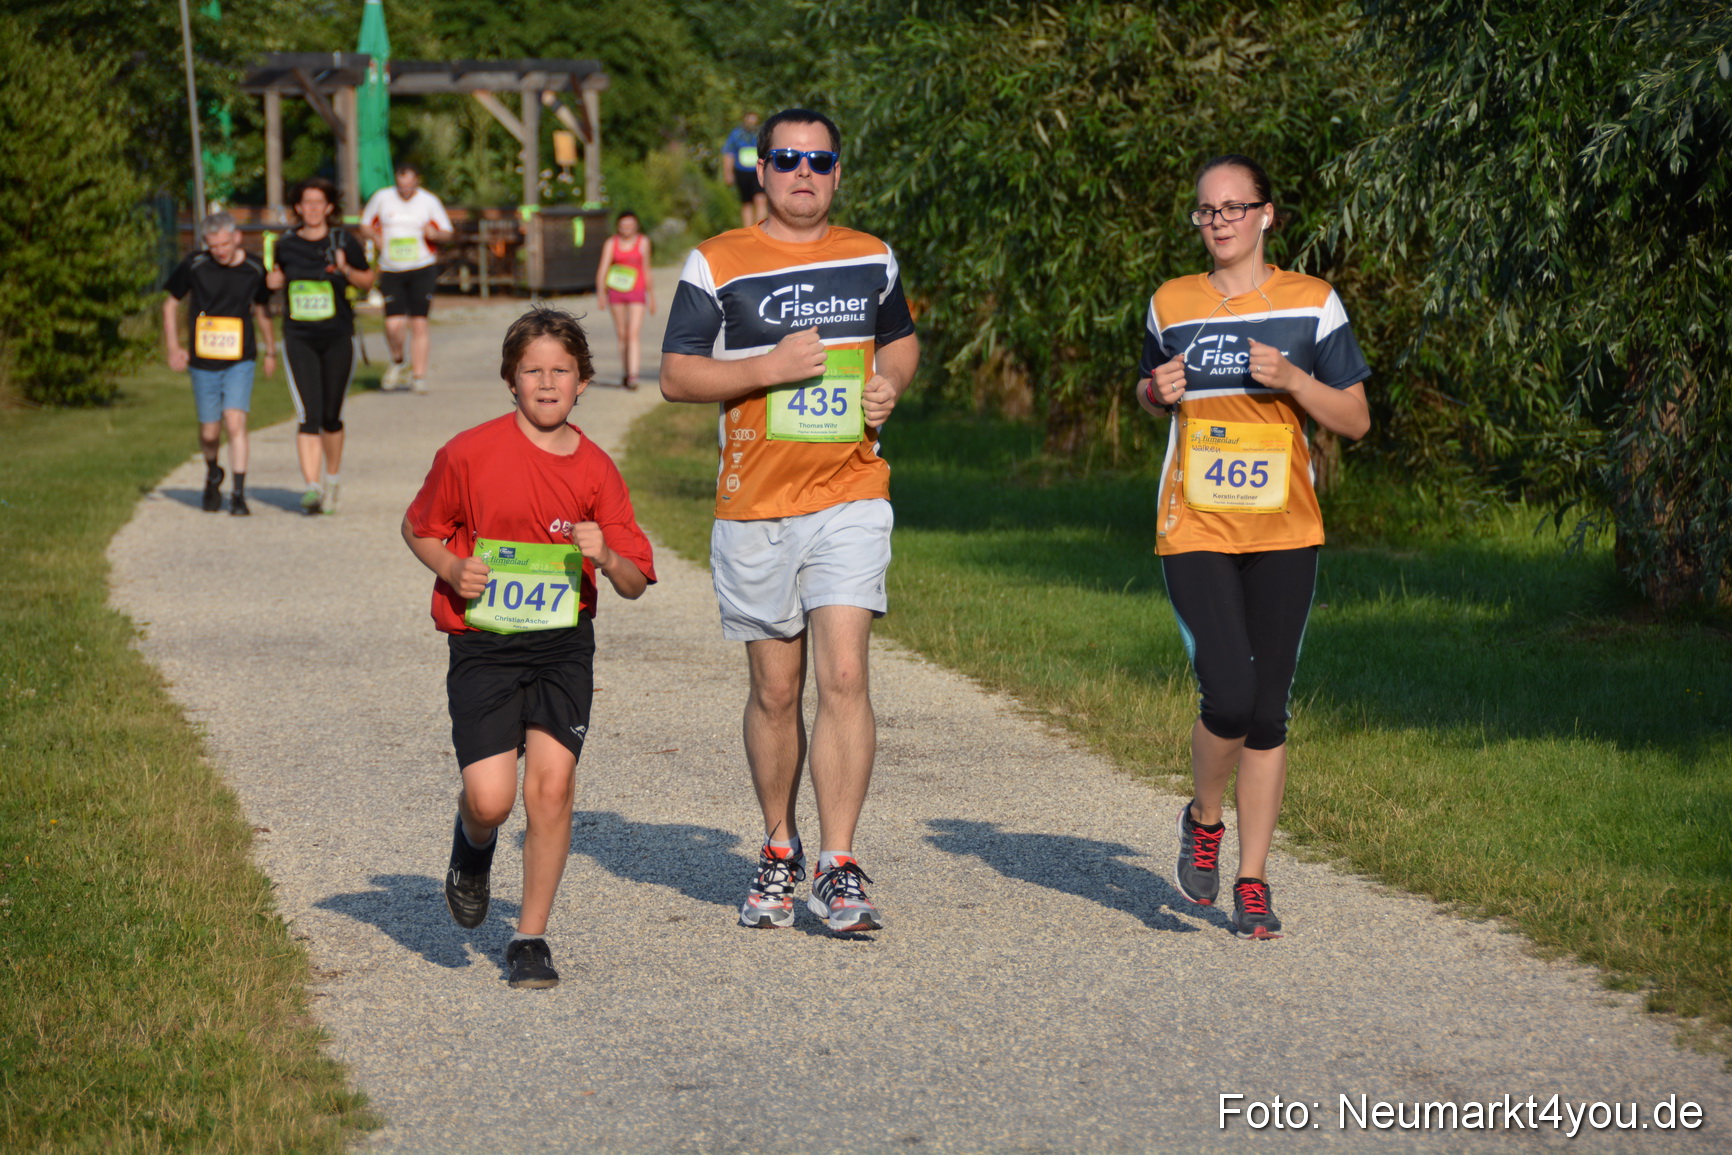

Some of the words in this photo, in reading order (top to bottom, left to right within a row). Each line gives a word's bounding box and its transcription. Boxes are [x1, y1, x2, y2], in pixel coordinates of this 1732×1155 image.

[781, 296, 867, 318] Fischer
[790, 313, 866, 328] AUTOMOBILE
[787, 387, 848, 416] 435
[1204, 458, 1269, 488] 465
[1212, 492, 1236, 500] Kerstin
[484, 578, 570, 612] 1047
[494, 614, 525, 624] Christian
[525, 617, 549, 625] Ascher
